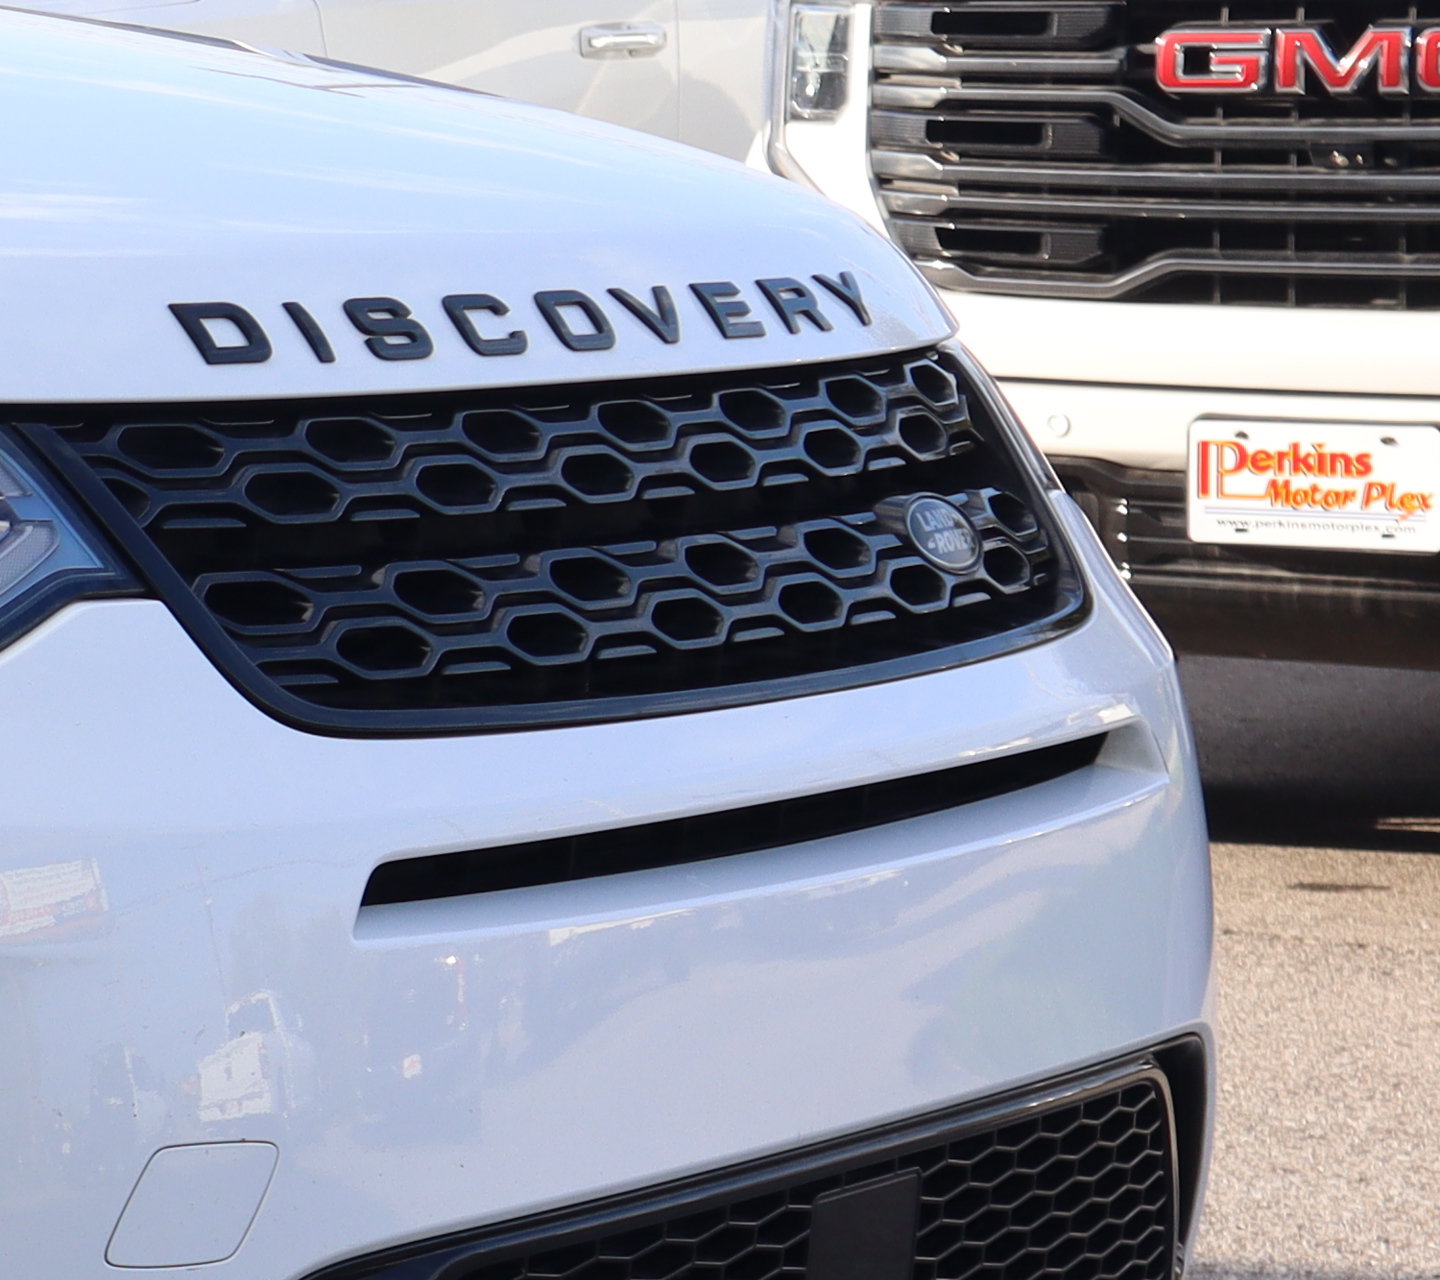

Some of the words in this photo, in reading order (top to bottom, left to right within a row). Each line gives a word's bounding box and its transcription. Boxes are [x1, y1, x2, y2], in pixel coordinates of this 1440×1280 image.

[1155, 24, 1440, 95] GM
[167, 269, 875, 365] DISCOVERY
[1197, 439, 1374, 498] Perkins
[915, 508, 957, 533] LAND
[1265, 478, 1357, 511] Motor
[1361, 480, 1434, 522] Plex
